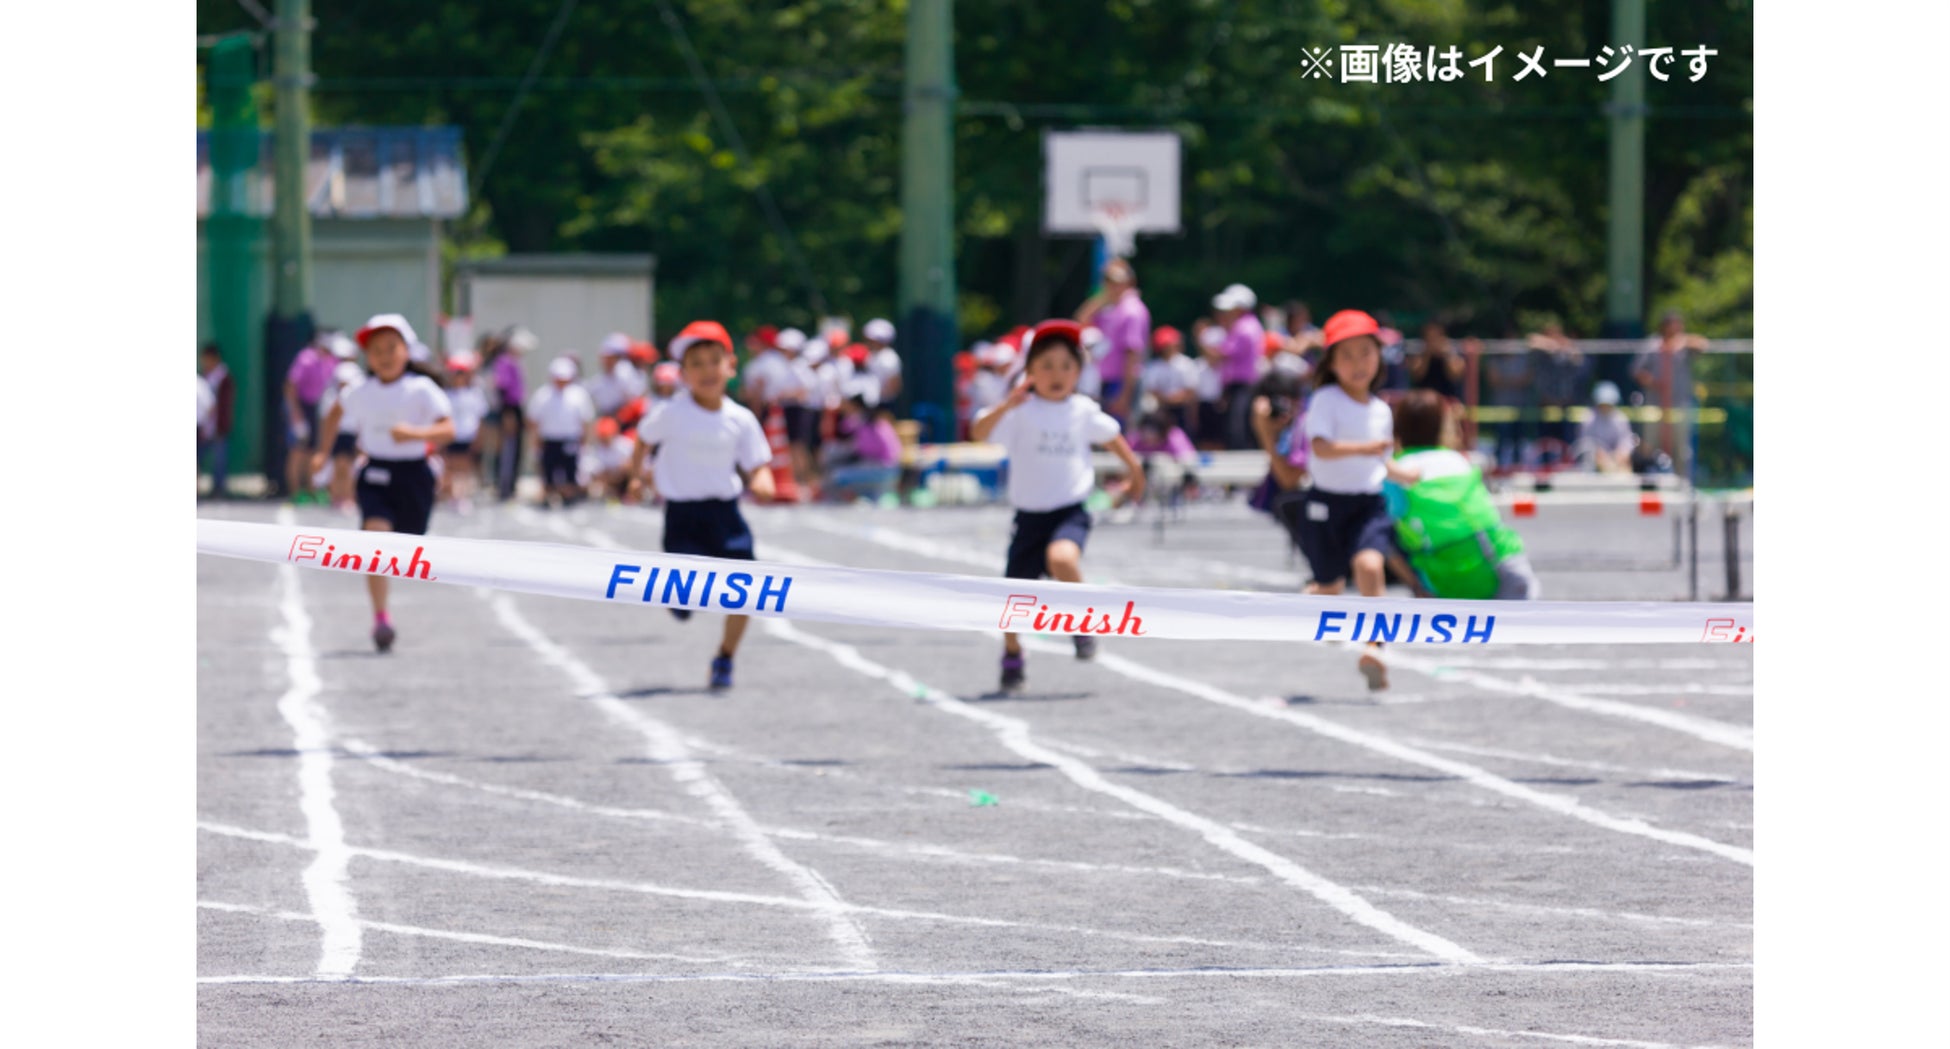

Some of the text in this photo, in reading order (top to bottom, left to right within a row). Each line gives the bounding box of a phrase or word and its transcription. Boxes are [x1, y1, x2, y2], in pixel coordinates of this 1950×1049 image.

[288, 534, 438, 581] Finish
[605, 564, 793, 612] FINISH
[999, 594, 1147, 636] Finish
[1313, 611, 1496, 643] FINISH
[1700, 617, 1754, 643] Fi
